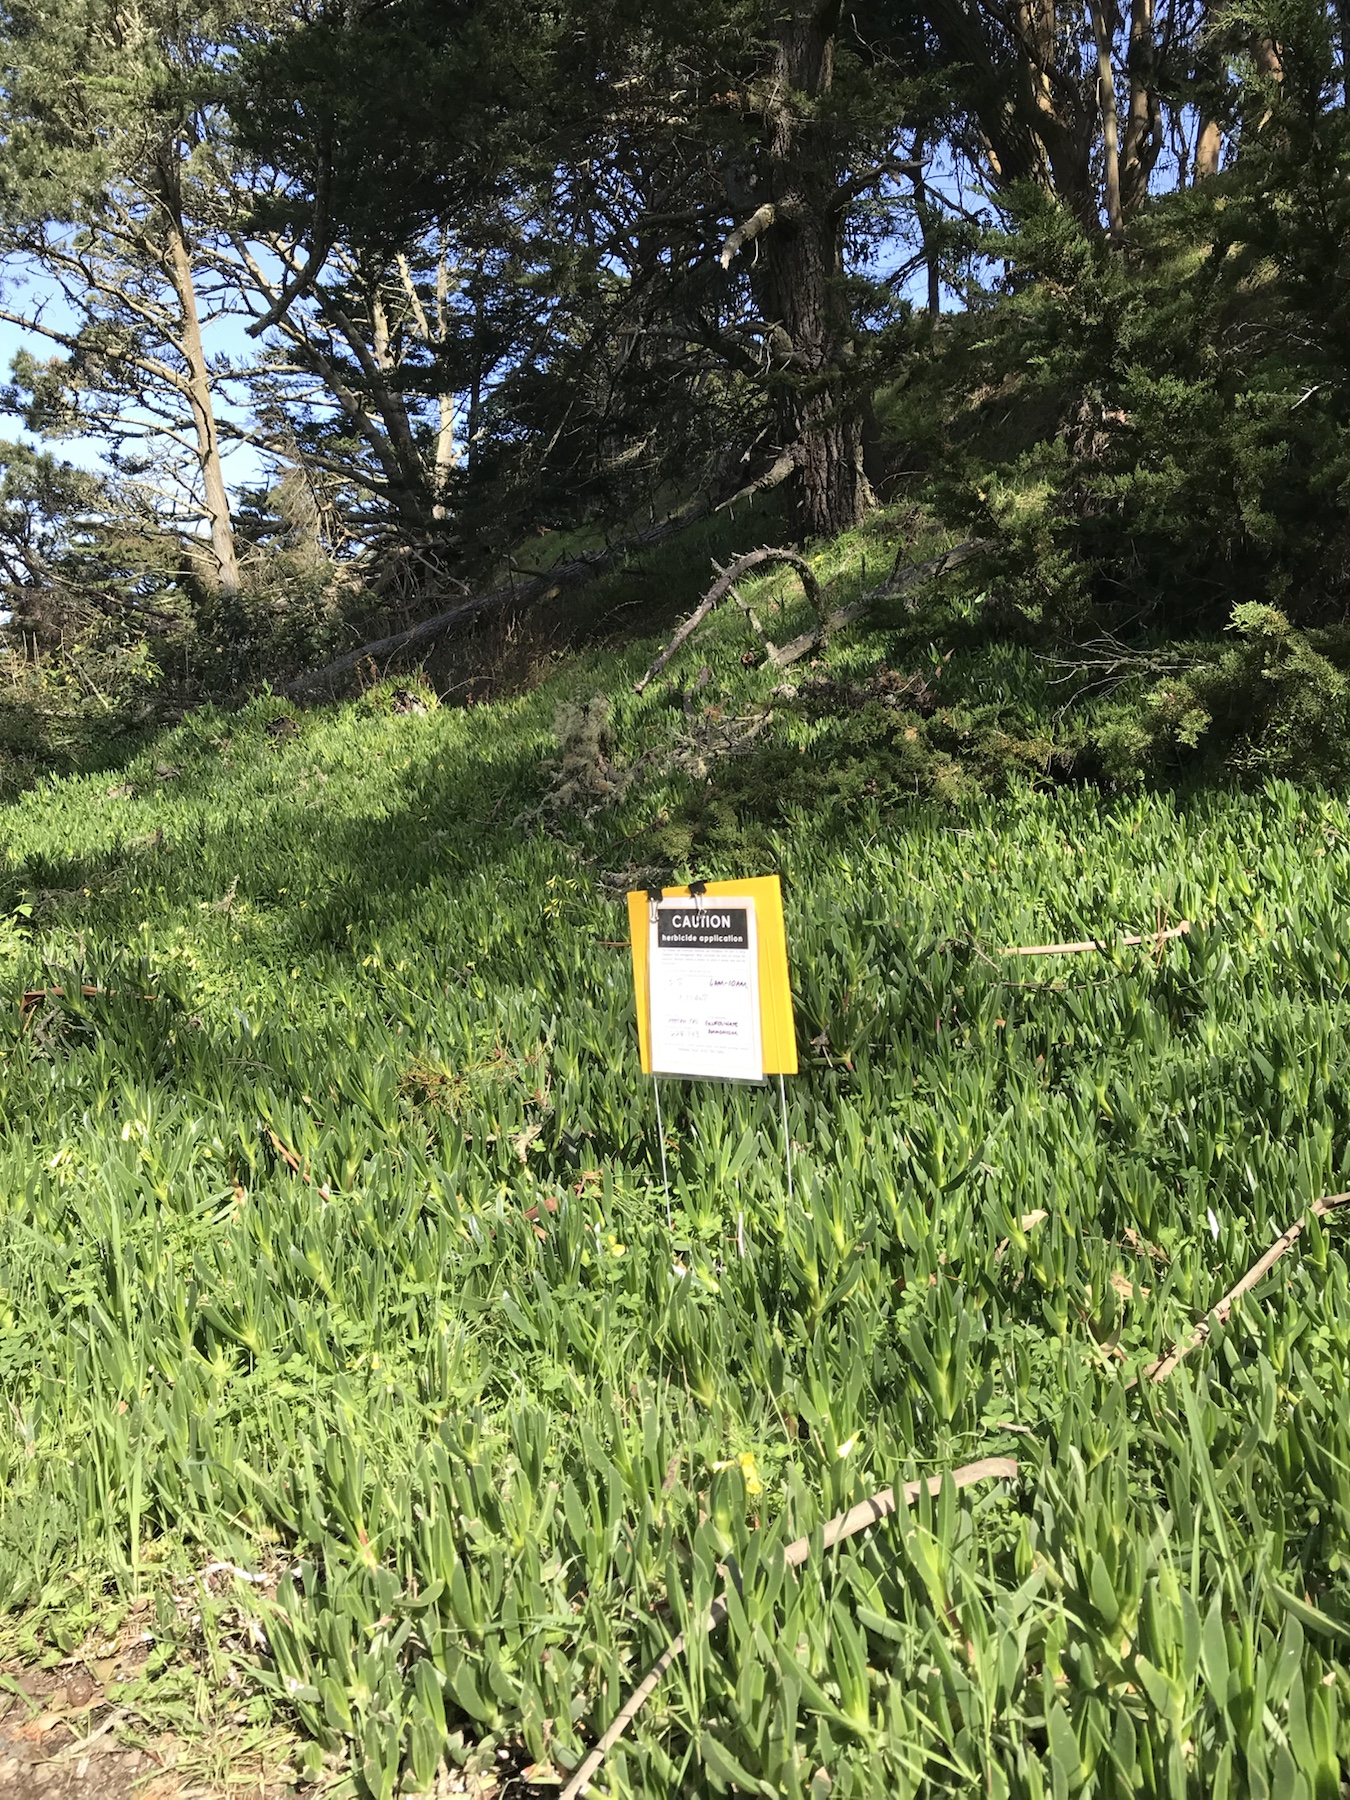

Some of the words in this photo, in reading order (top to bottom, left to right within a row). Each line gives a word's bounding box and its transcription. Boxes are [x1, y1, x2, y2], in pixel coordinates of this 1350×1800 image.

[672, 914, 731, 928] CAUTION
[661, 933, 698, 942] herbicide
[699, 934, 743, 944] application
